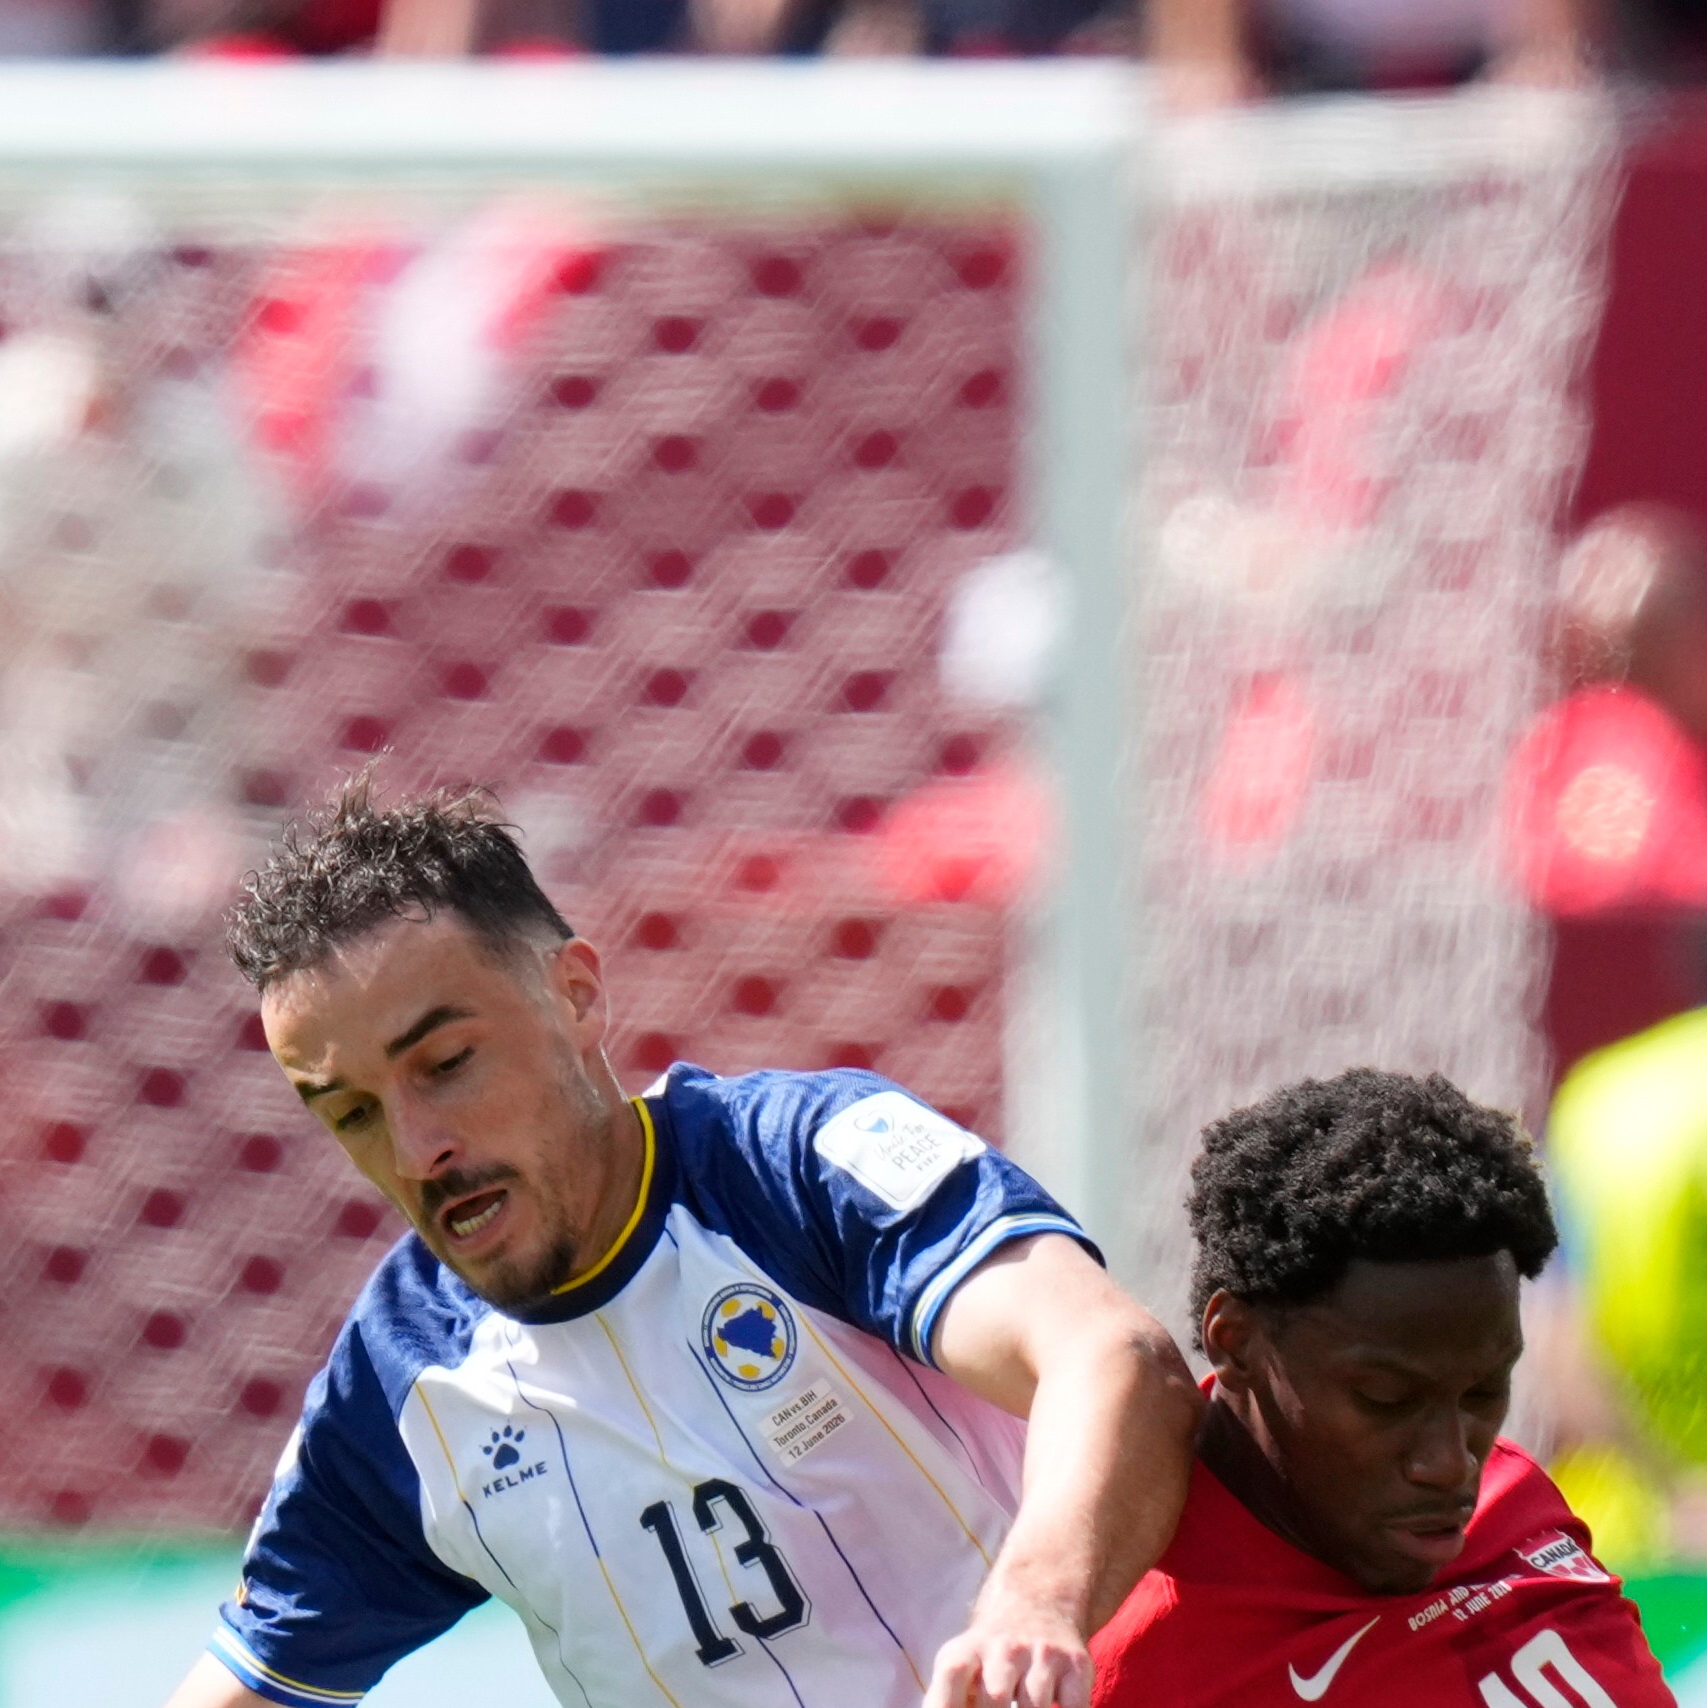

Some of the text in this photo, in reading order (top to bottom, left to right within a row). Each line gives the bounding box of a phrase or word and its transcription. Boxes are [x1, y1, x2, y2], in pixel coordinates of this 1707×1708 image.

[892, 1134, 941, 1170] PEACE
[772, 1407, 793, 1427] CAN
[805, 1398, 838, 1425] Canada
[788, 1413, 846, 1459] 12 June 2026
[482, 1461, 547, 1499] KELME
[1530, 1539, 1581, 1568] CANADA
[639, 1478, 811, 1668] 13
[1407, 1598, 1450, 1632] BOSNIA
[1465, 1592, 1492, 1615] JUNE
